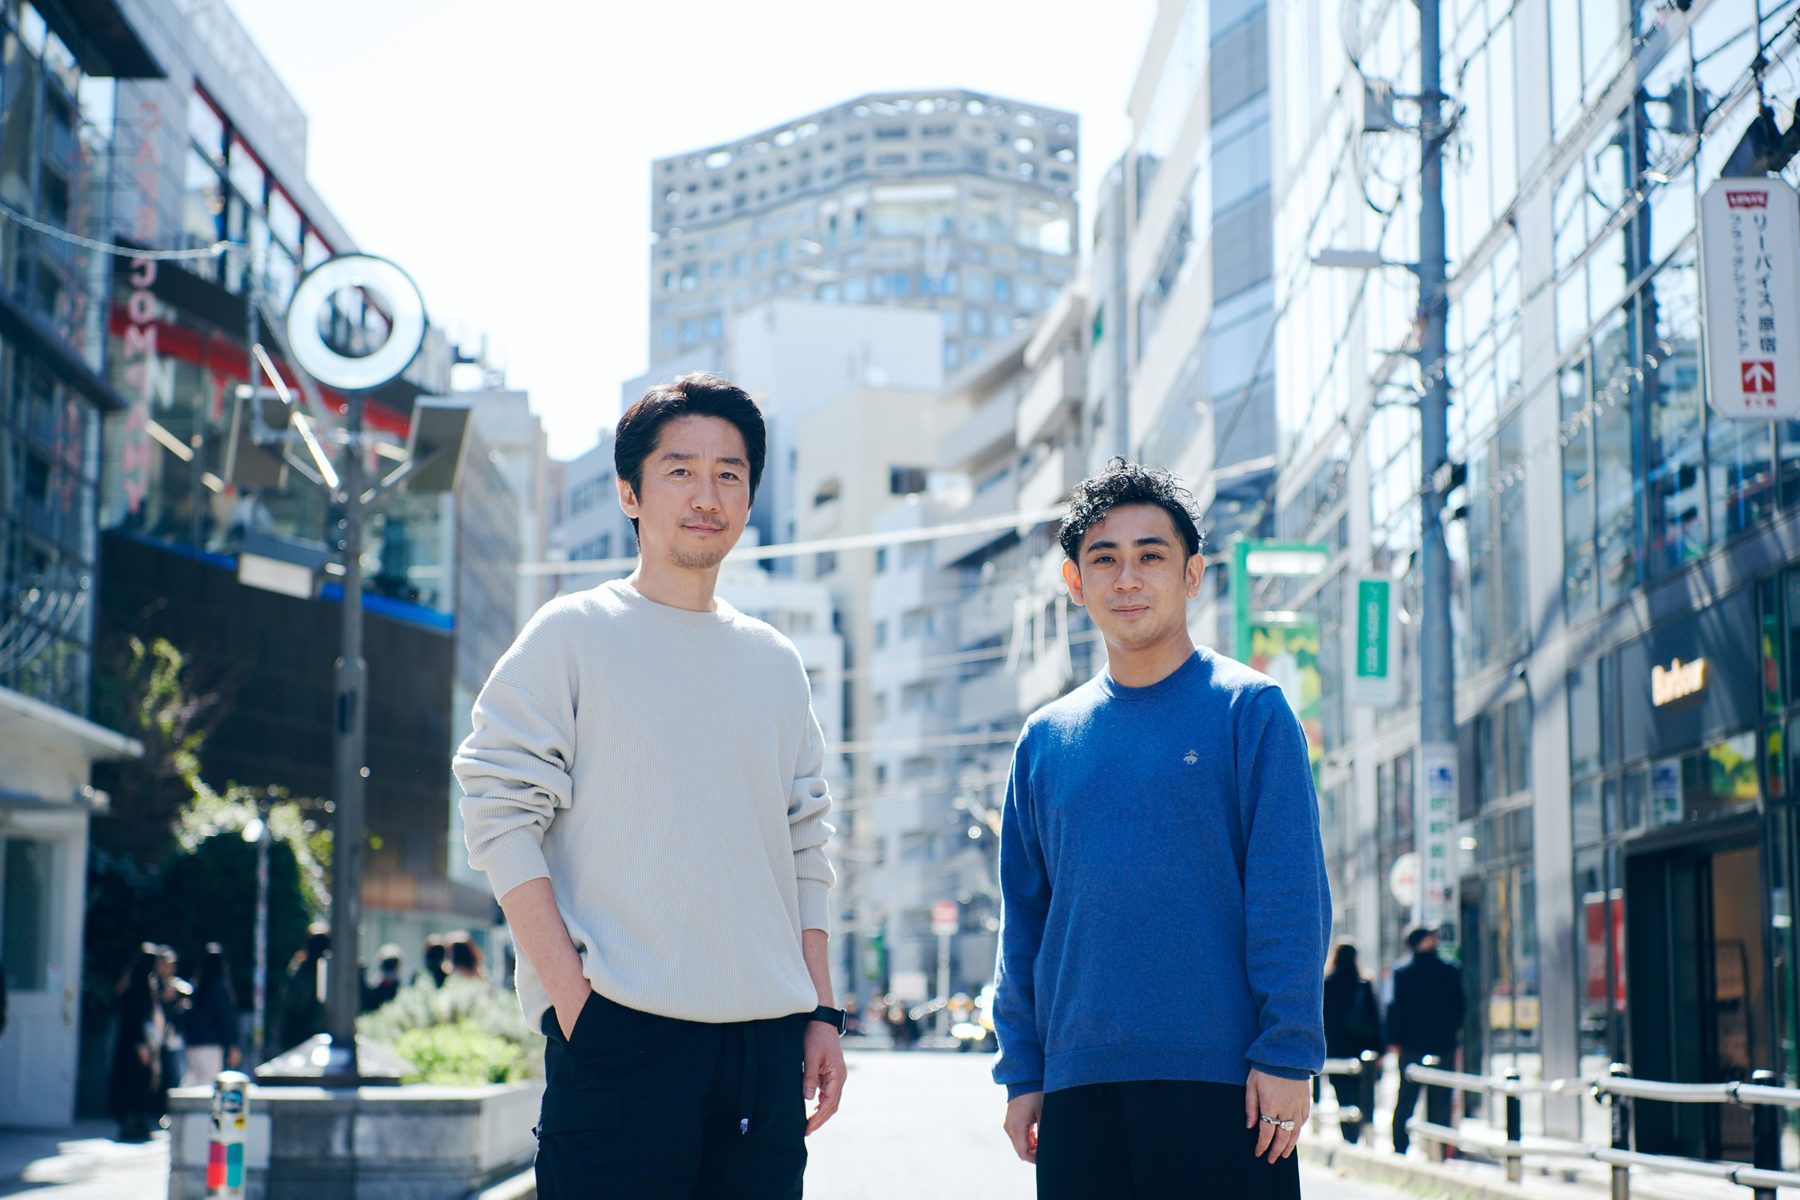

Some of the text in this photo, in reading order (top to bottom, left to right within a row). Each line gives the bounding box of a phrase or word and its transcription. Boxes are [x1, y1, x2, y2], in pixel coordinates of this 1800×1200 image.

[1754, 213, 1777, 354] リーバイス原宿
